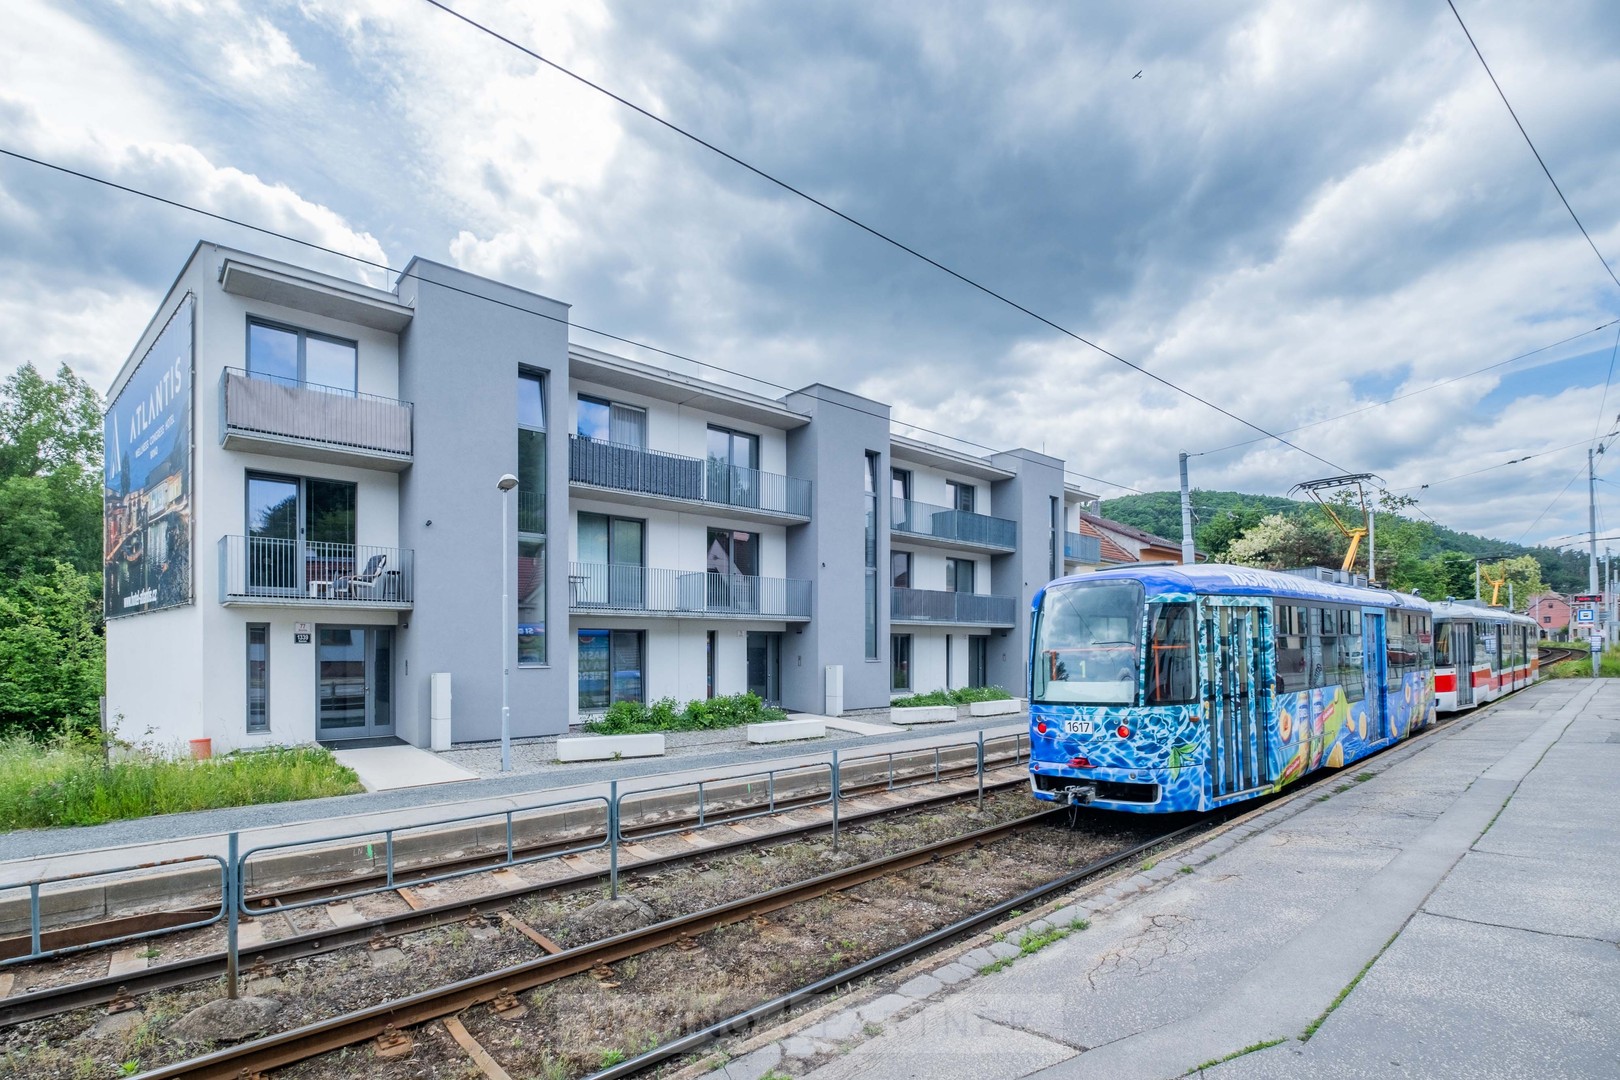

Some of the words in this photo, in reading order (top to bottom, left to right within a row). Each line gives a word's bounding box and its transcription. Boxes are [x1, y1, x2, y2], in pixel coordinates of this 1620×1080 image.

[131, 357, 182, 443] ATLANTIS
[1080, 660, 1086, 678] 1
[1067, 722, 1090, 733] 1617
